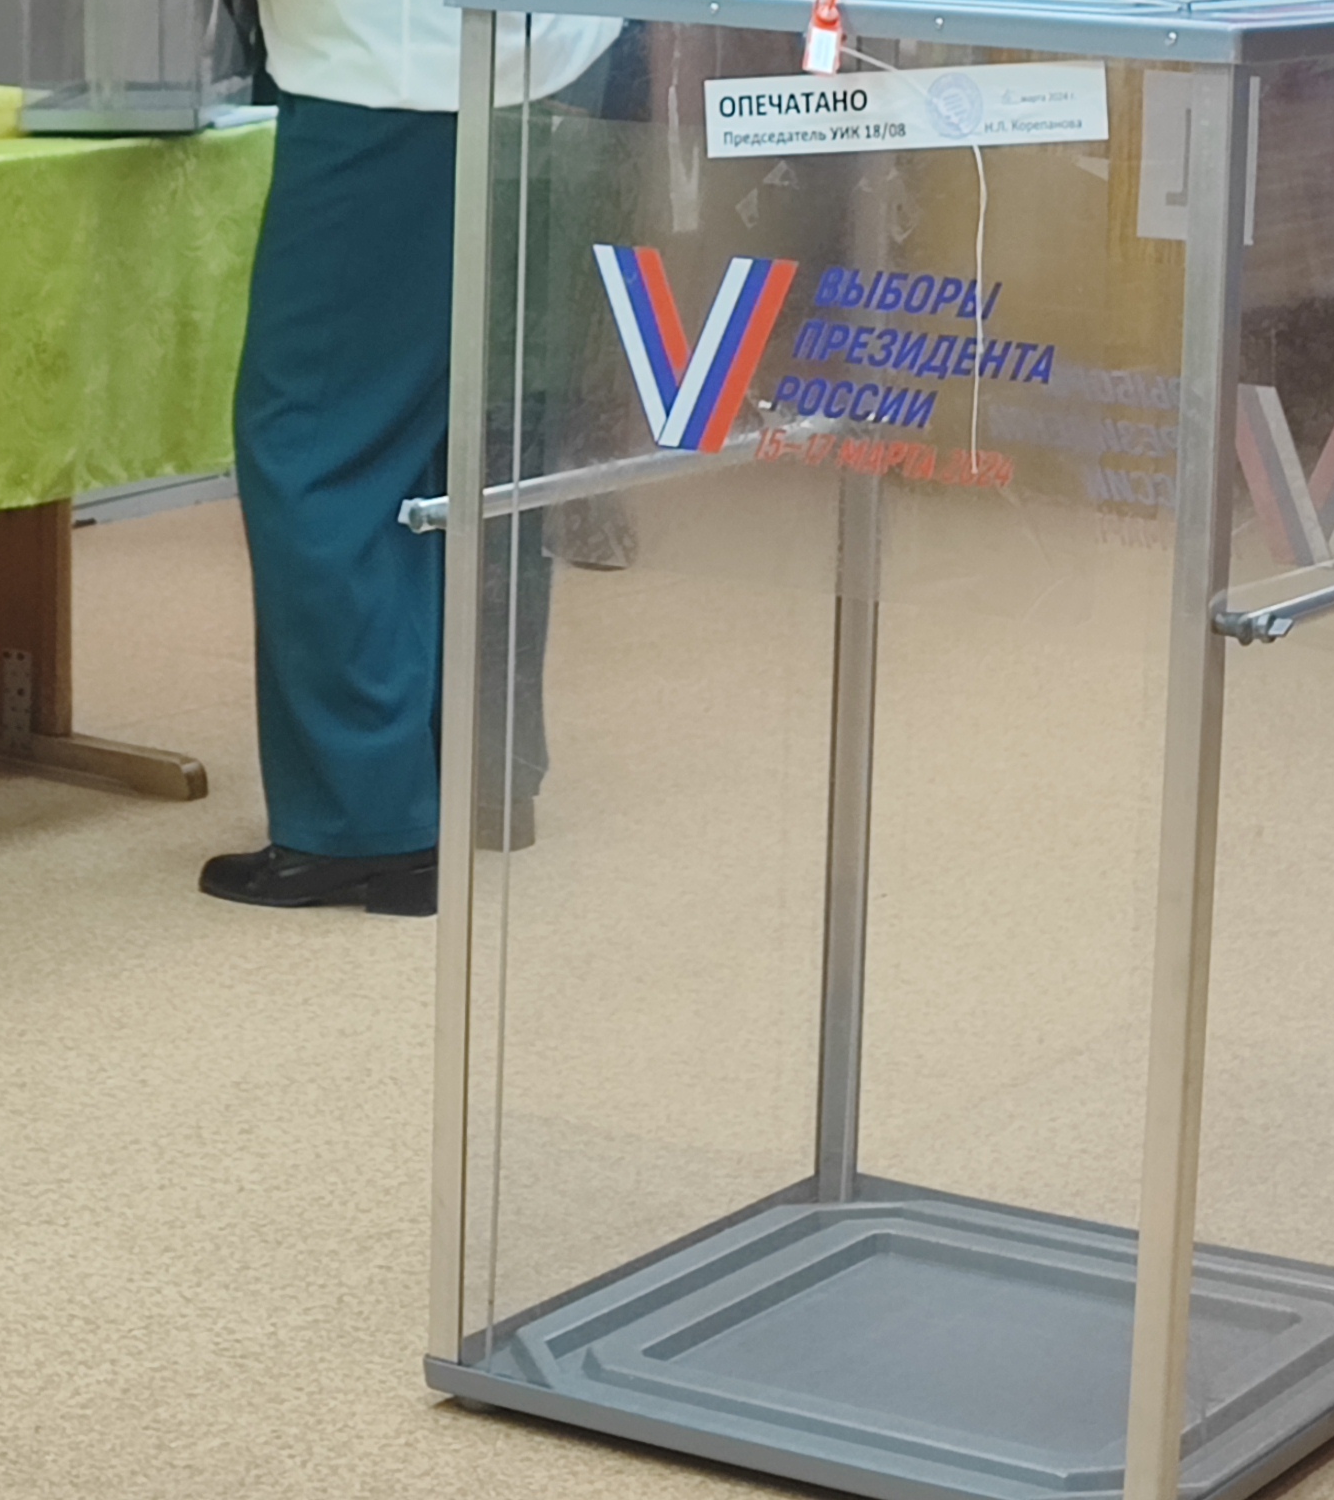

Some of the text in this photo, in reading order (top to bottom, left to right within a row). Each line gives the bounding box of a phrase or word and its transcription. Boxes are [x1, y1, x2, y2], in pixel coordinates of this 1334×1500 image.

[719, 89, 868, 118] ОПЕЧАТАНО
[723, 121, 907, 147] Председатель УИК 18/08
[815, 266, 1003, 321] ВЫБОРЫ
[792, 317, 1055, 385] ПРЕЗИДЕНТА
[770, 375, 938, 429] РОССИИ
[837, 437, 937, 477] МАРТА
